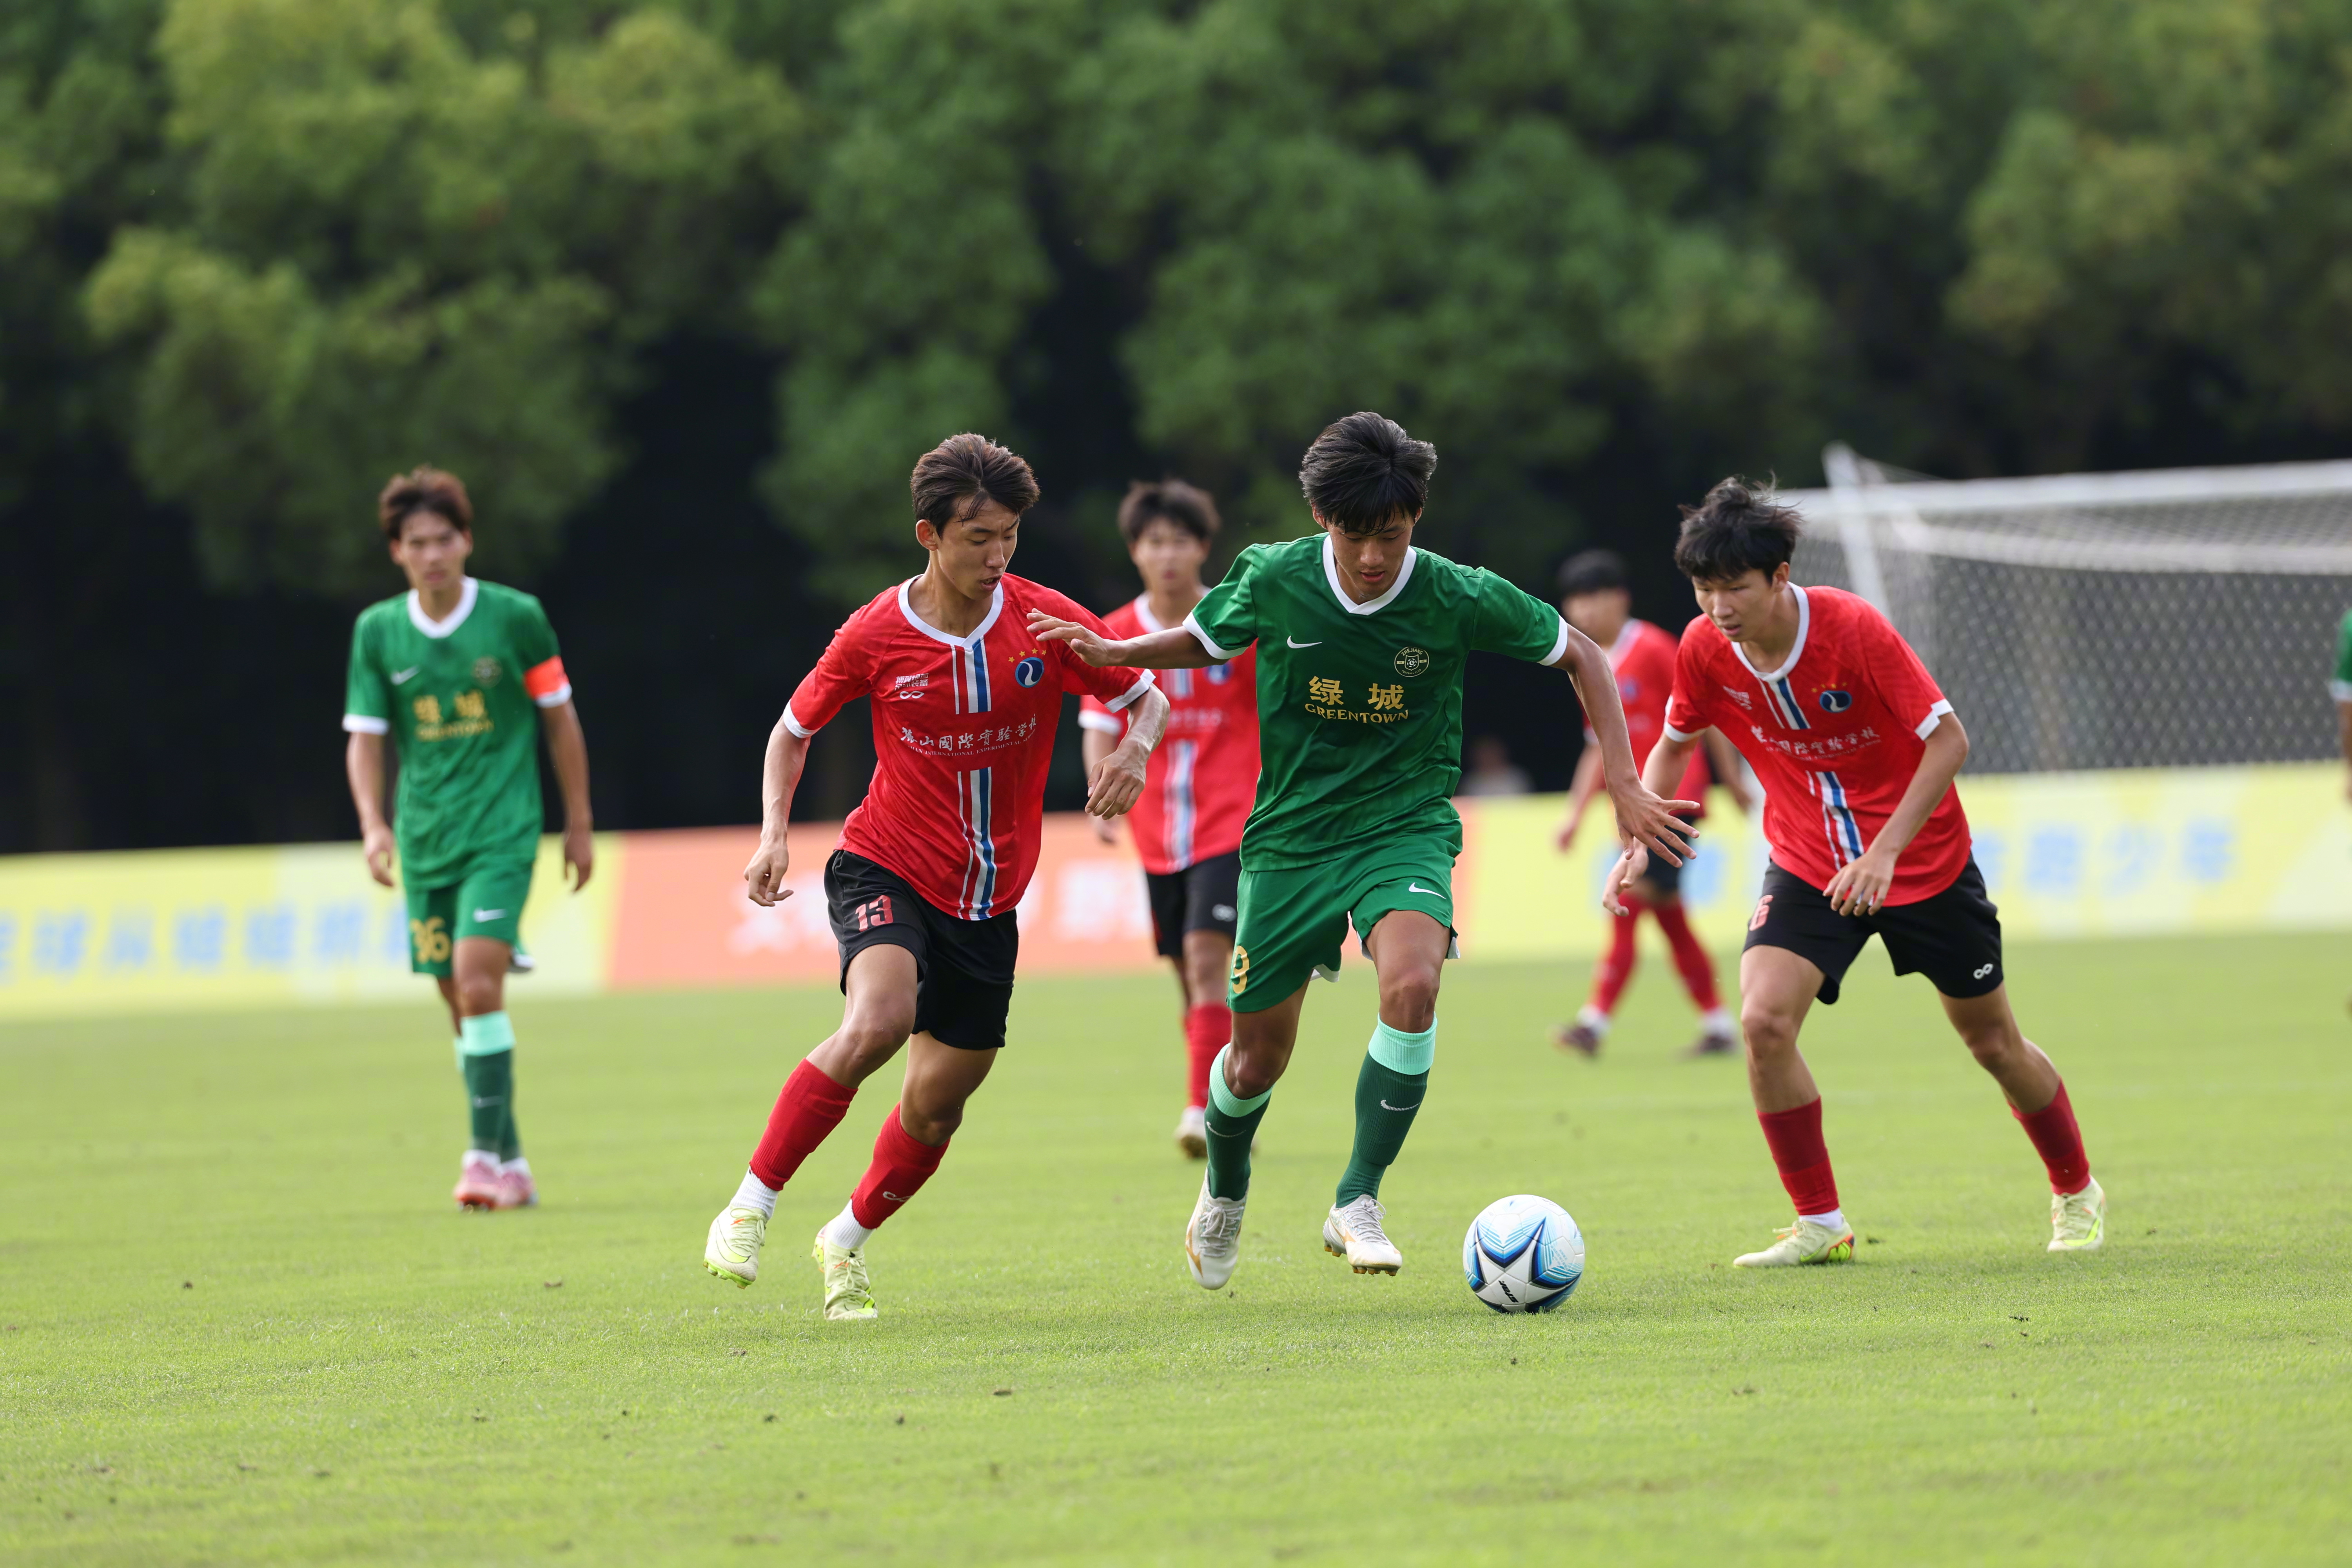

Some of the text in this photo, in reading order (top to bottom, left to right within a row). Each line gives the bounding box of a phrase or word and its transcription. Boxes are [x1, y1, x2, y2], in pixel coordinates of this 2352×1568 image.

[1401, 648, 1423, 656] ZHEJIANG
[1308, 675, 1404, 711] 绿城
[1305, 703, 1408, 724] GREENTOWN
[976, 740, 1021, 754] EXPERIMENTAL
[855, 895, 893, 932] 13
[1232, 945, 1250, 994] 9
